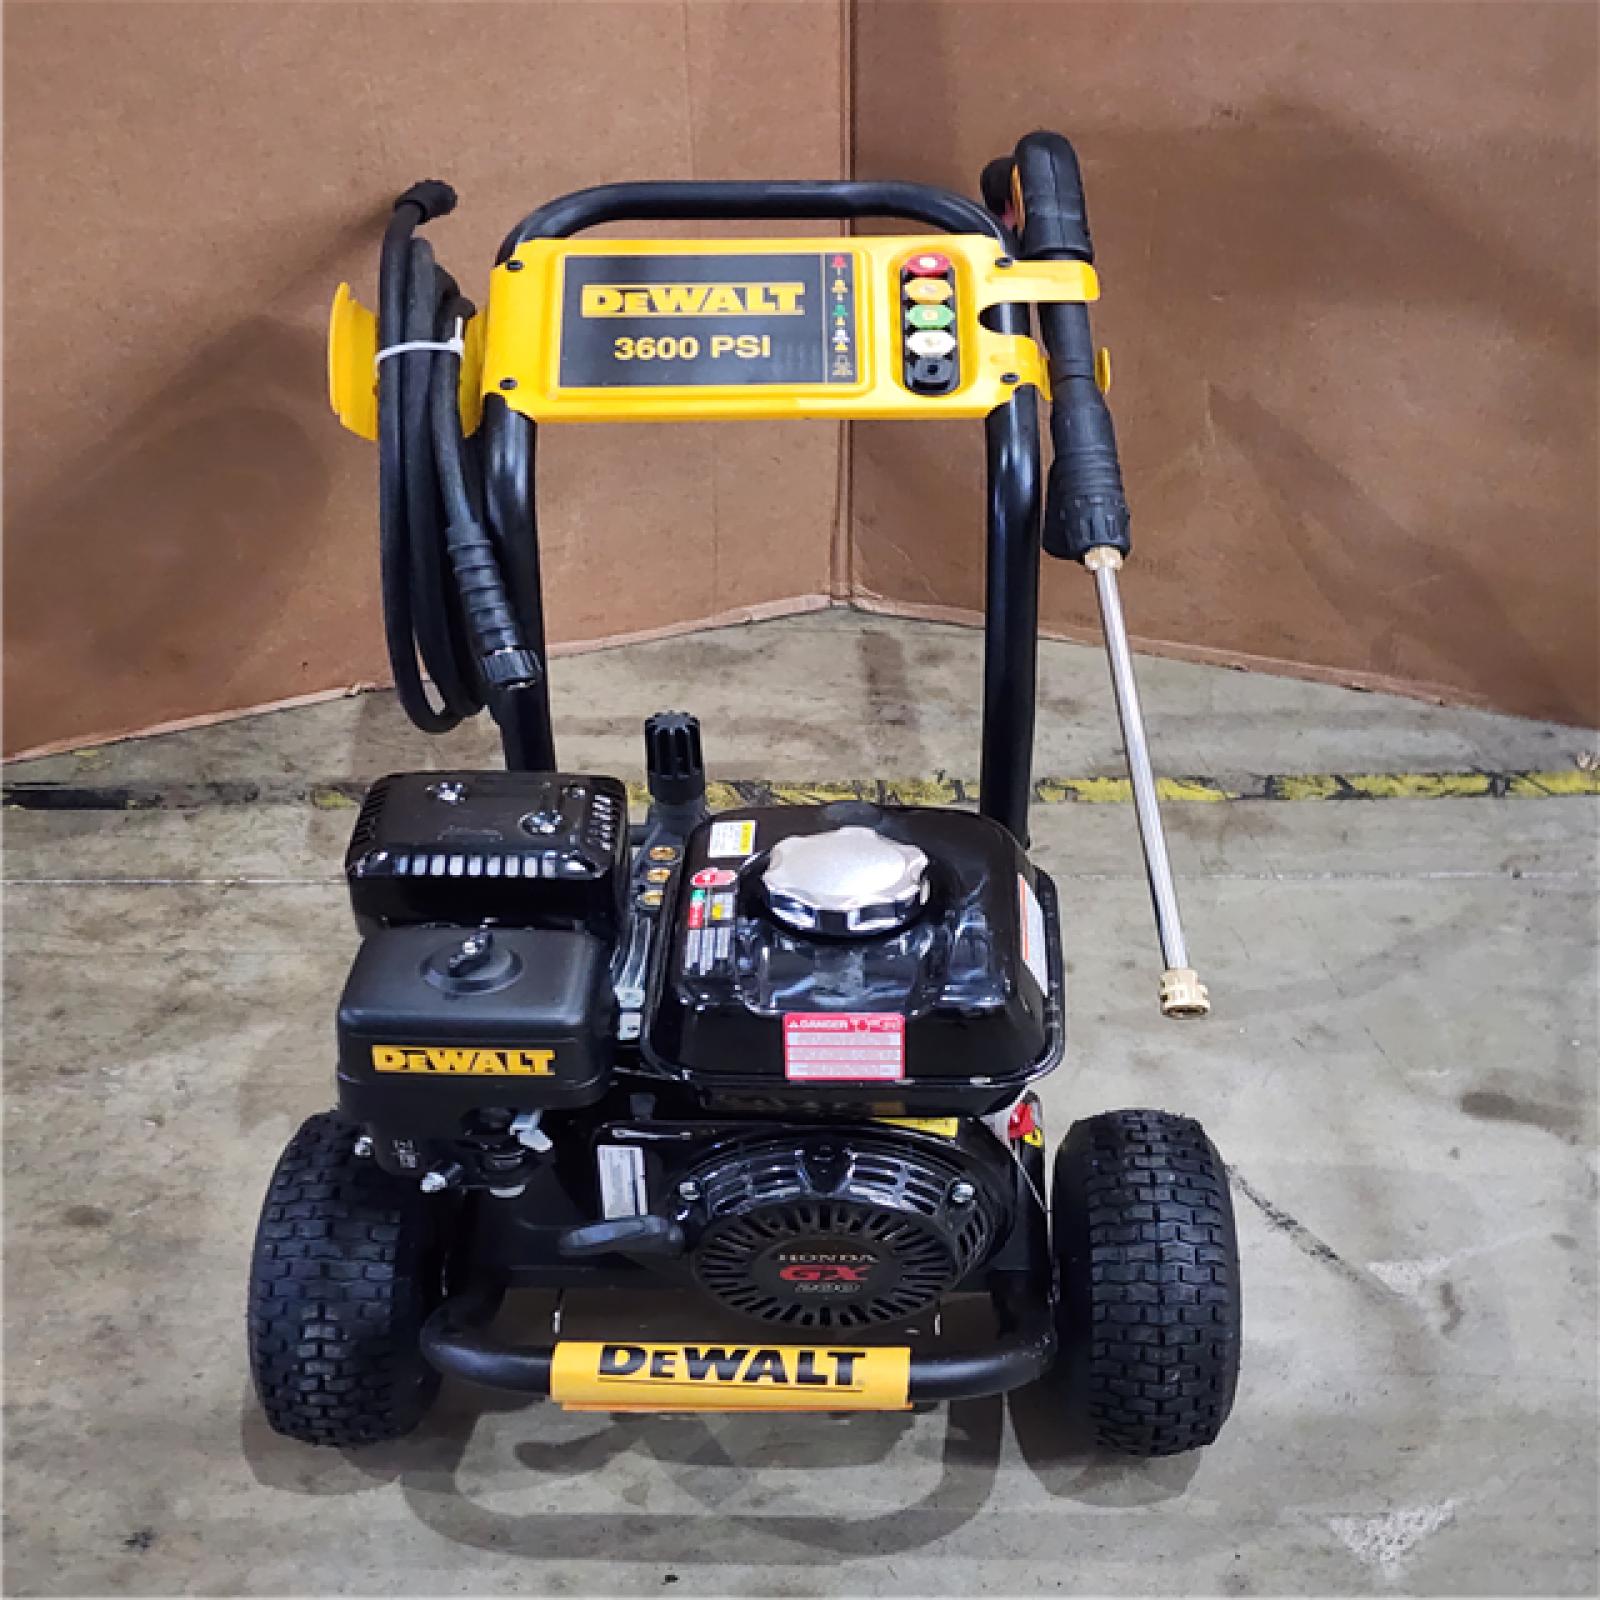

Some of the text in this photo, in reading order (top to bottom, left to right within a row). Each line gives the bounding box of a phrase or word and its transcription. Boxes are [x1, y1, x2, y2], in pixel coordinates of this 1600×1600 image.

[614, 334, 771, 360] 3600 PSI
[779, 1264, 872, 1281] GX
